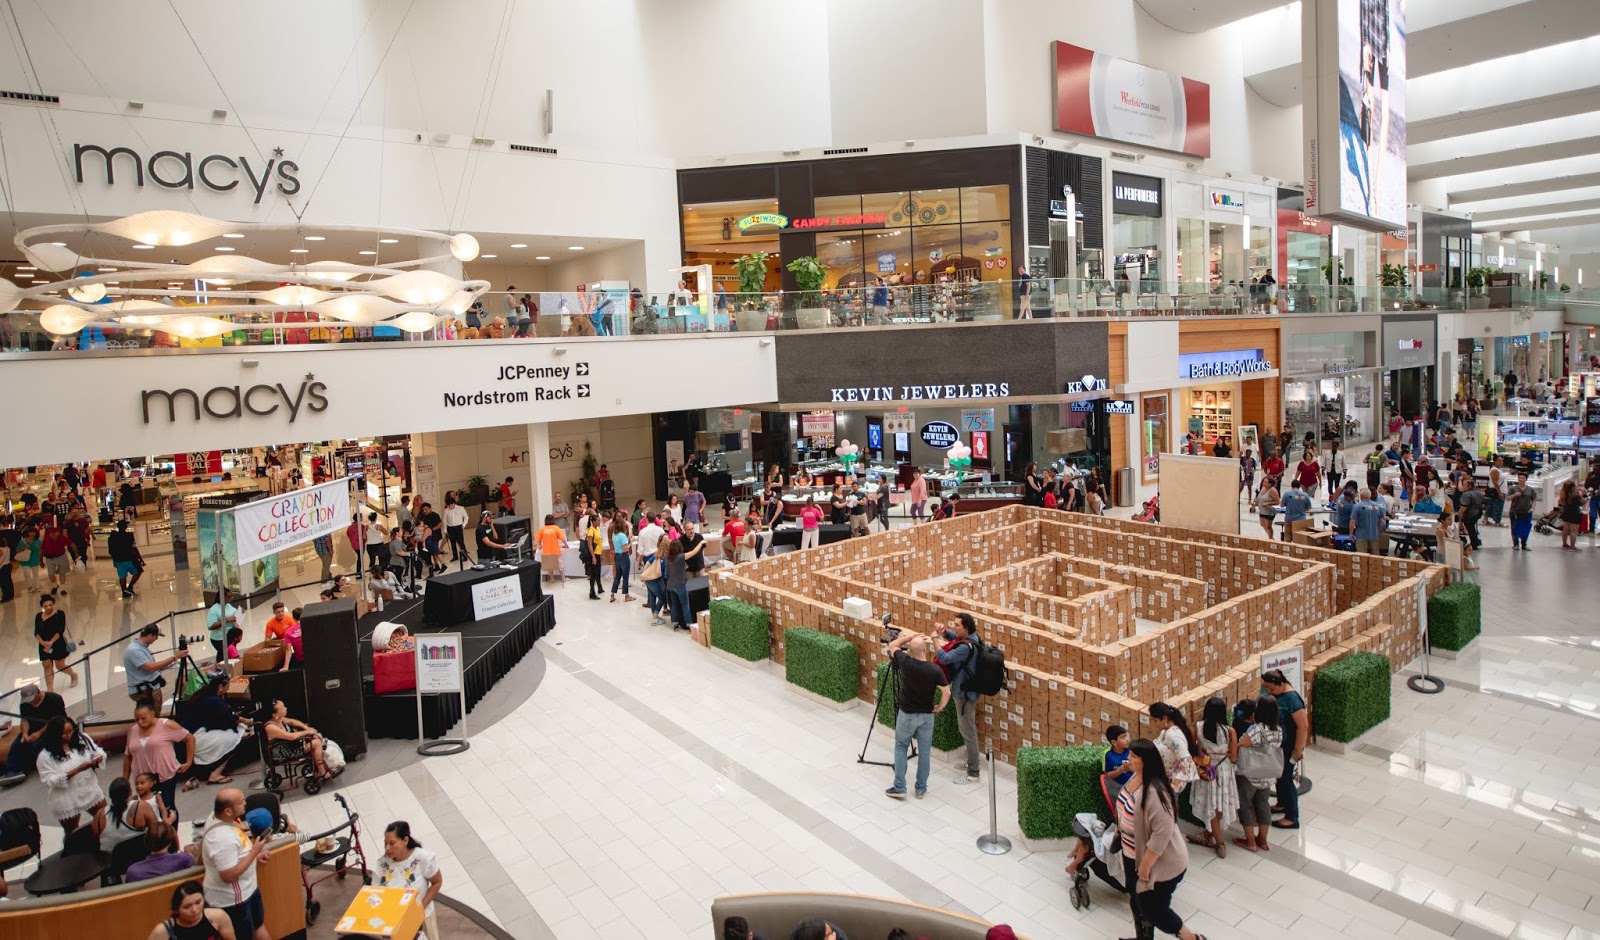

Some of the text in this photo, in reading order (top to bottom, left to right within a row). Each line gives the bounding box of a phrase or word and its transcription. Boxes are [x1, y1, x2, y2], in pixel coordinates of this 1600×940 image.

[1115, 186, 1158, 204] LA PERFUMERIE
[1306, 180, 1317, 209] Westfield
[743, 213, 887, 228] FUZZIWIG'S CANDY FACTORY
[497, 365, 570, 380] JCPenney
[1190, 359, 1271, 378] Bath & Body Works
[444, 386, 571, 407] Nordstrom Rack
[831, 383, 1010, 402] KEVIN JEWELERS
[922, 432, 956, 441] JEWELERS
[928, 425, 949, 433] KEVIN
[187, 452, 211, 463] DAY
[187, 461, 211, 470] SALE
[271, 490, 322, 519] CRAYON
[258, 505, 335, 542] COLLECTION
[264, 523, 333, 551] COLLECT CONTRIBUTE CREATE
[480, 588, 513, 600] COLLECTION
[482, 600, 516, 612] Crayon Collection
